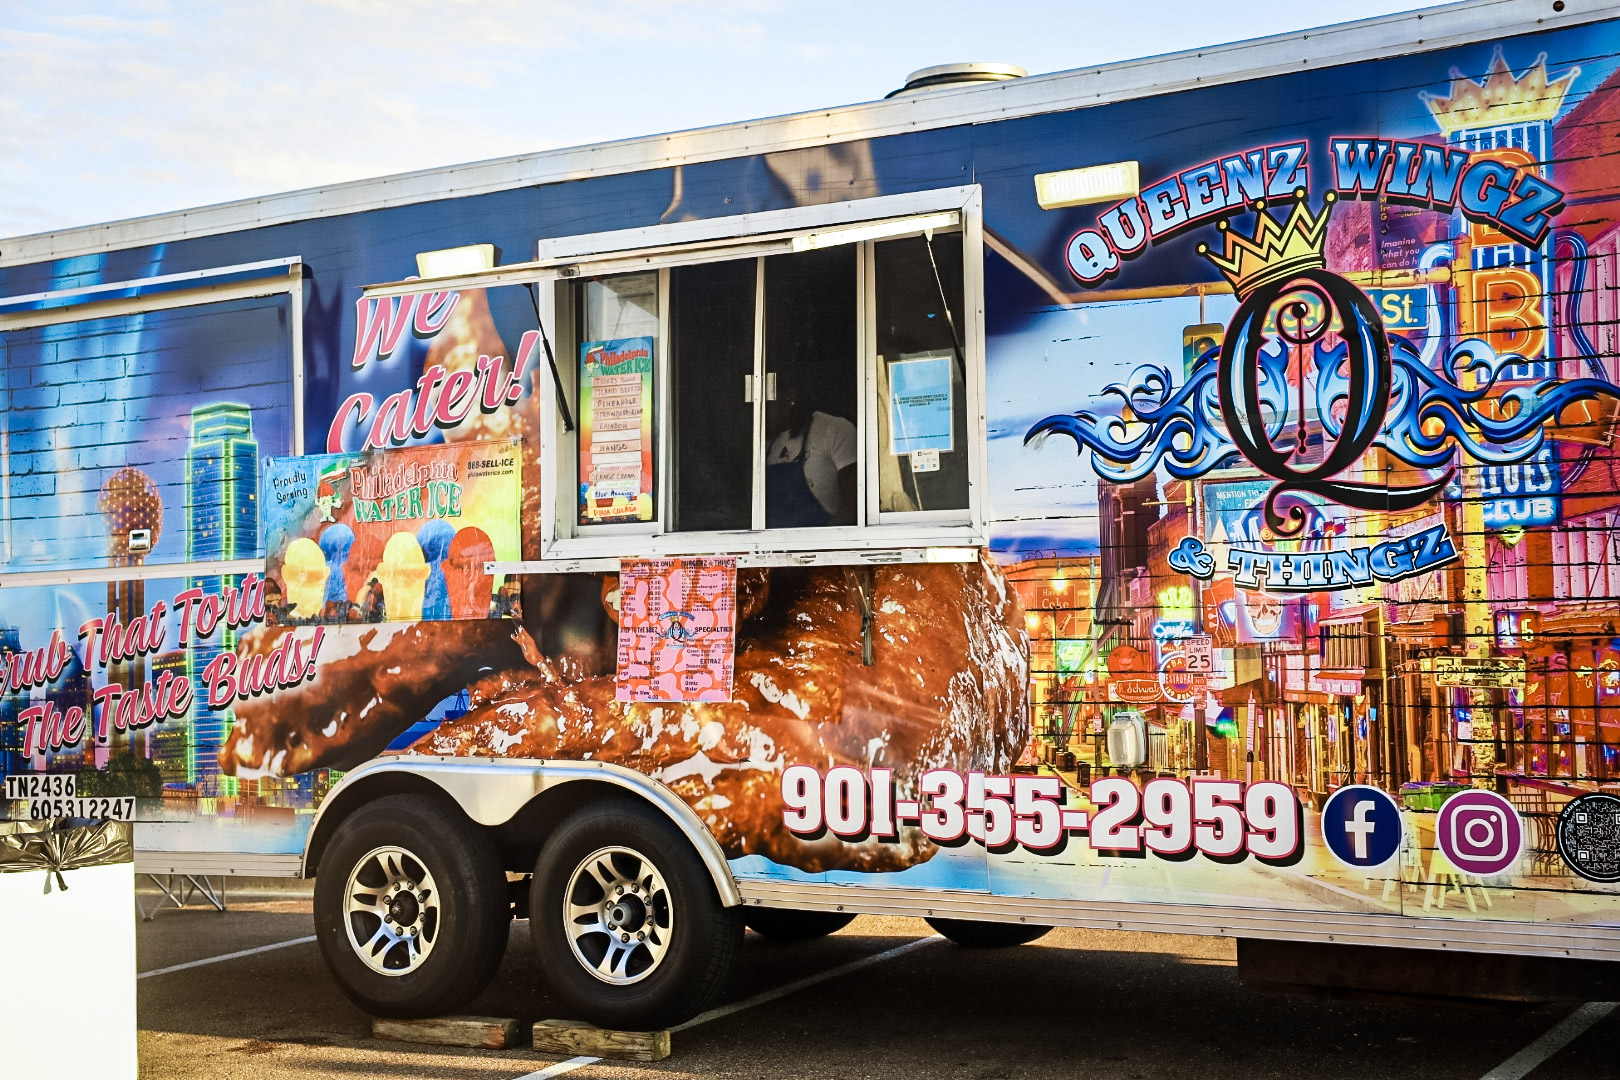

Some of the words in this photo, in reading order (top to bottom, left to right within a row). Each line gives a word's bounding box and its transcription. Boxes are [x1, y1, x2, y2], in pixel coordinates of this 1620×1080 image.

[1066, 139, 1308, 282] QUEENZ
[1330, 137, 1566, 252] WINGZ
[1381, 237, 1416, 249] Imagine
[1382, 249, 1403, 259] what
[1404, 248, 1420, 258] you
[1382, 260, 1398, 269] can
[1399, 258, 1410, 266] do
[1381, 293, 1418, 325] St.
[352, 290, 461, 367] We
[600, 359, 633, 376] WATER
[634, 356, 651, 373] ICE
[326, 330, 540, 453] Cater!
[598, 398, 636, 407] PINEAPPLE
[600, 444, 628, 452] MANGO
[468, 458, 514, 470] 888-SELL-ICE
[273, 470, 307, 489] Proudly
[349, 460, 458, 500] Philadelphia
[276, 488, 308, 504] Serving
[352, 486, 424, 523] WATER
[427, 480, 462, 518] ICE
[1216, 490, 1246, 499] MENTION
[1167, 535, 1215, 580] &
[1228, 522, 1458, 592] THINGZ
[1042, 598, 1069, 609] Coke
[79, 600, 166, 672] That
[1188, 654, 1210, 669] 25
[18, 702, 86, 758] The
[94, 669, 193, 738] Taste
[203, 626, 325, 706] Buds!
[6, 776, 74, 798] TN2436
[30, 798, 135, 820] 605312247
[780, 764, 1300, 859] 901-355-2959
[1562, 804, 1576, 818] SCAN
